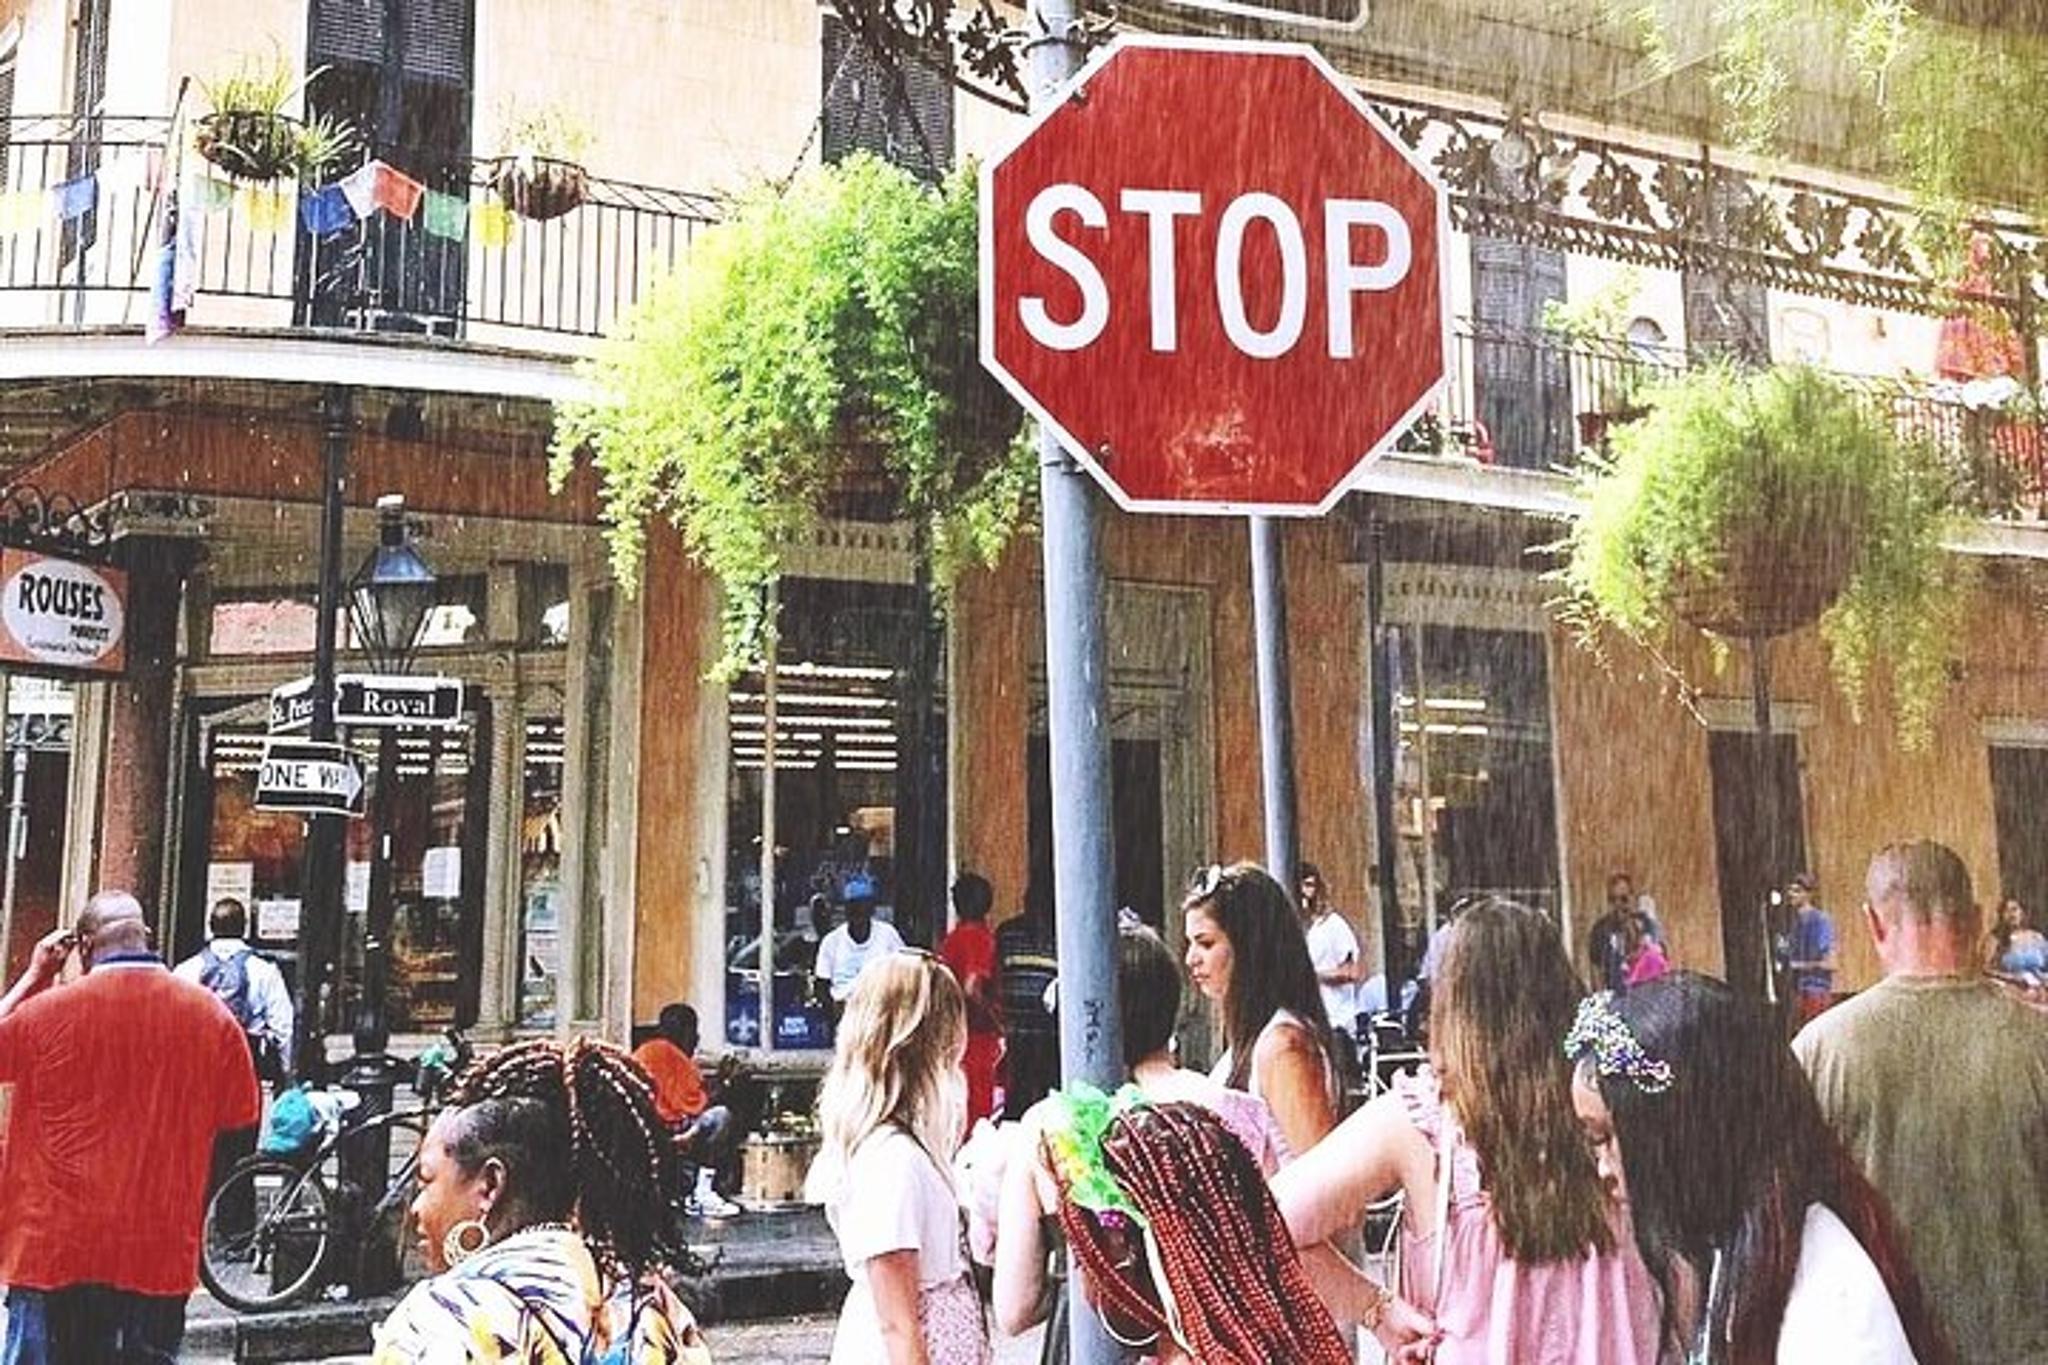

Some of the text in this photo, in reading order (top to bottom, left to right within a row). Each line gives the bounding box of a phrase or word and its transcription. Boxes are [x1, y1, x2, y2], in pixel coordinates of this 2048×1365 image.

[1018, 183, 1412, 359] STOP
[19, 572, 104, 621] ROUSES
[363, 690, 436, 716] Royal
[261, 763, 308, 788] ONE
